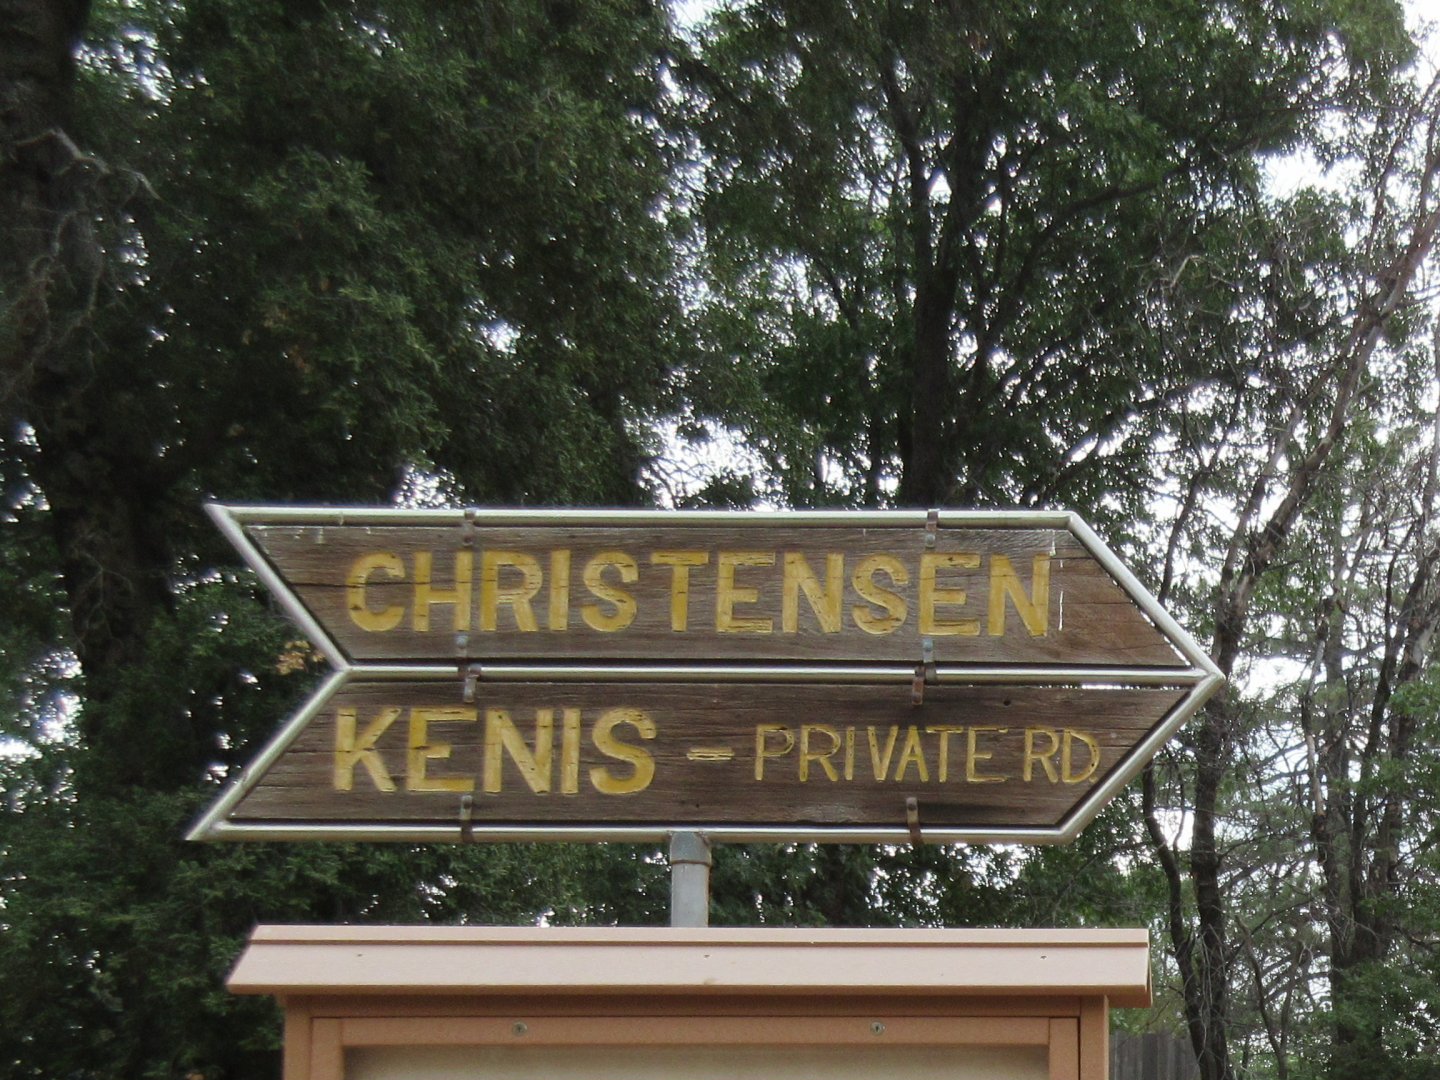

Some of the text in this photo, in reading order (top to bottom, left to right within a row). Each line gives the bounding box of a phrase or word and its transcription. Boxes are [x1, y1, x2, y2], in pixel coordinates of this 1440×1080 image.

[347, 549, 1051, 637] CHRISTENSEN
[333, 706, 659, 796] KENIS
[754, 725, 1007, 783] PRIVATE
[1022, 727, 1101, 785] RD
